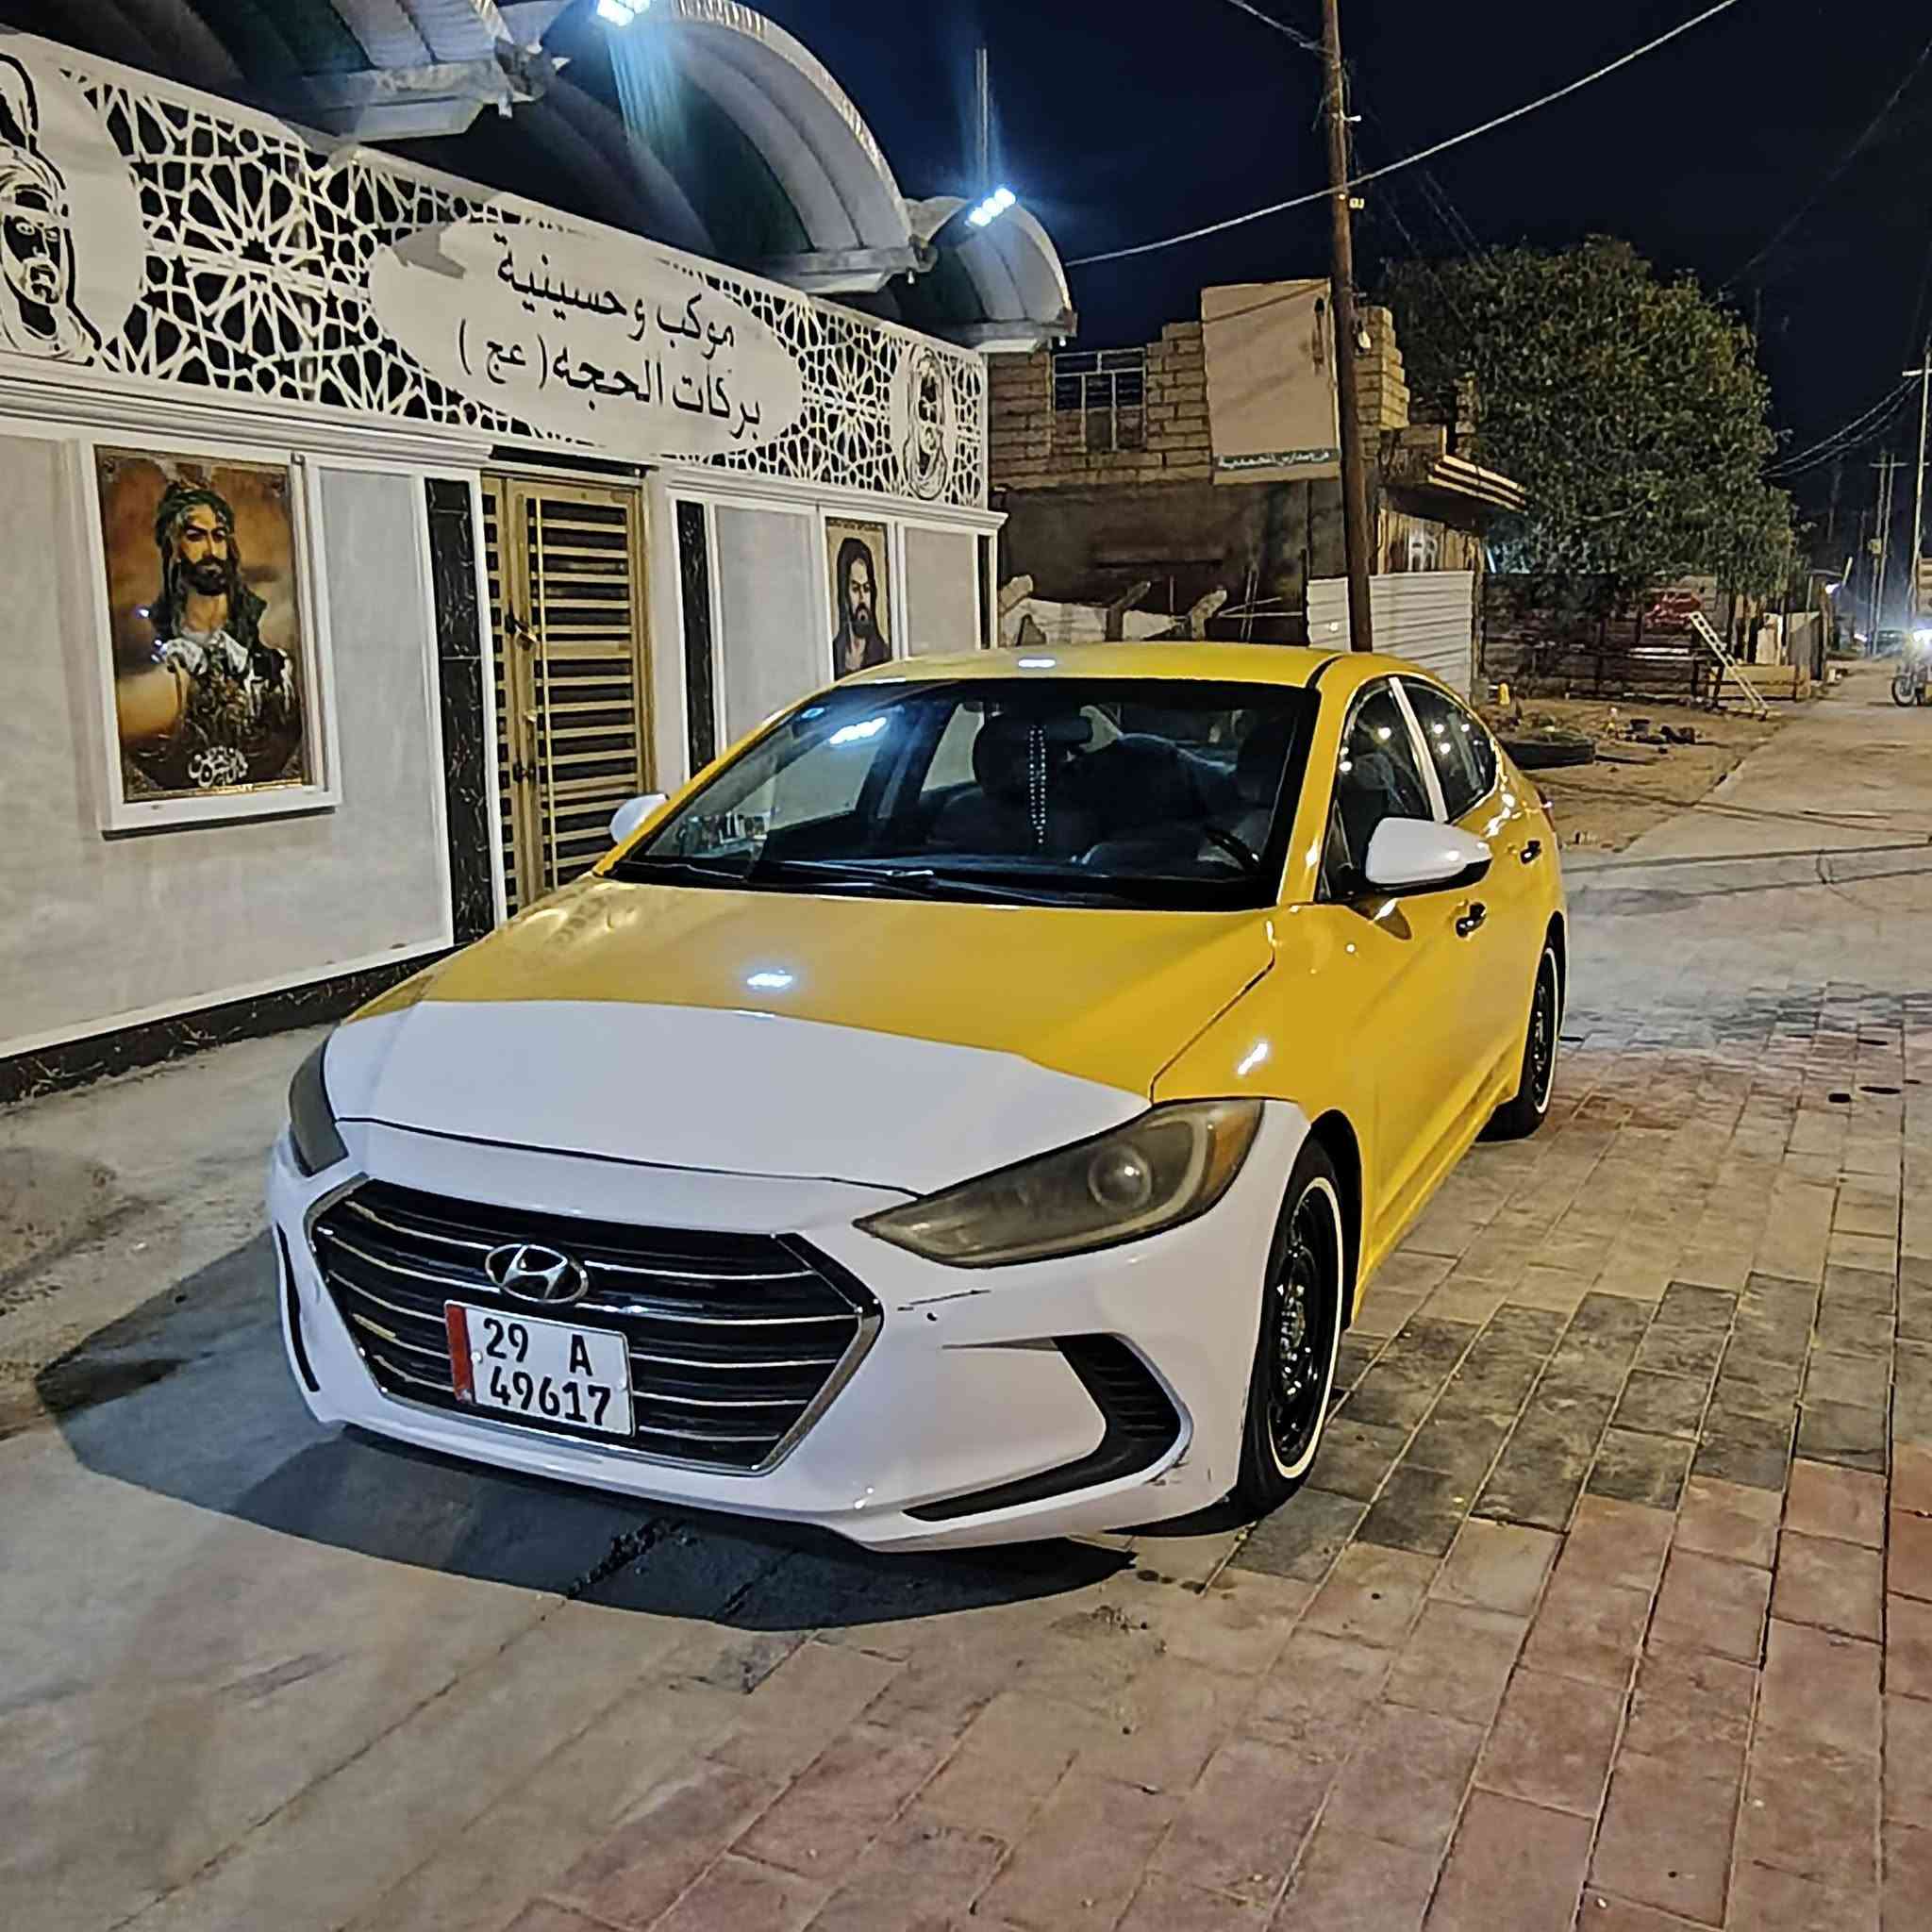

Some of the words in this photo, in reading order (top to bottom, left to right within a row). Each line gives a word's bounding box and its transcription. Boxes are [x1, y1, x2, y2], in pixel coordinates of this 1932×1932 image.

[657, 293, 735, 359] موكب
[673, 364, 762, 440] بركات
[483, 1317, 529, 1362] 29
[568, 1334, 593, 1376] A
[490, 1365, 611, 1425] 49617
